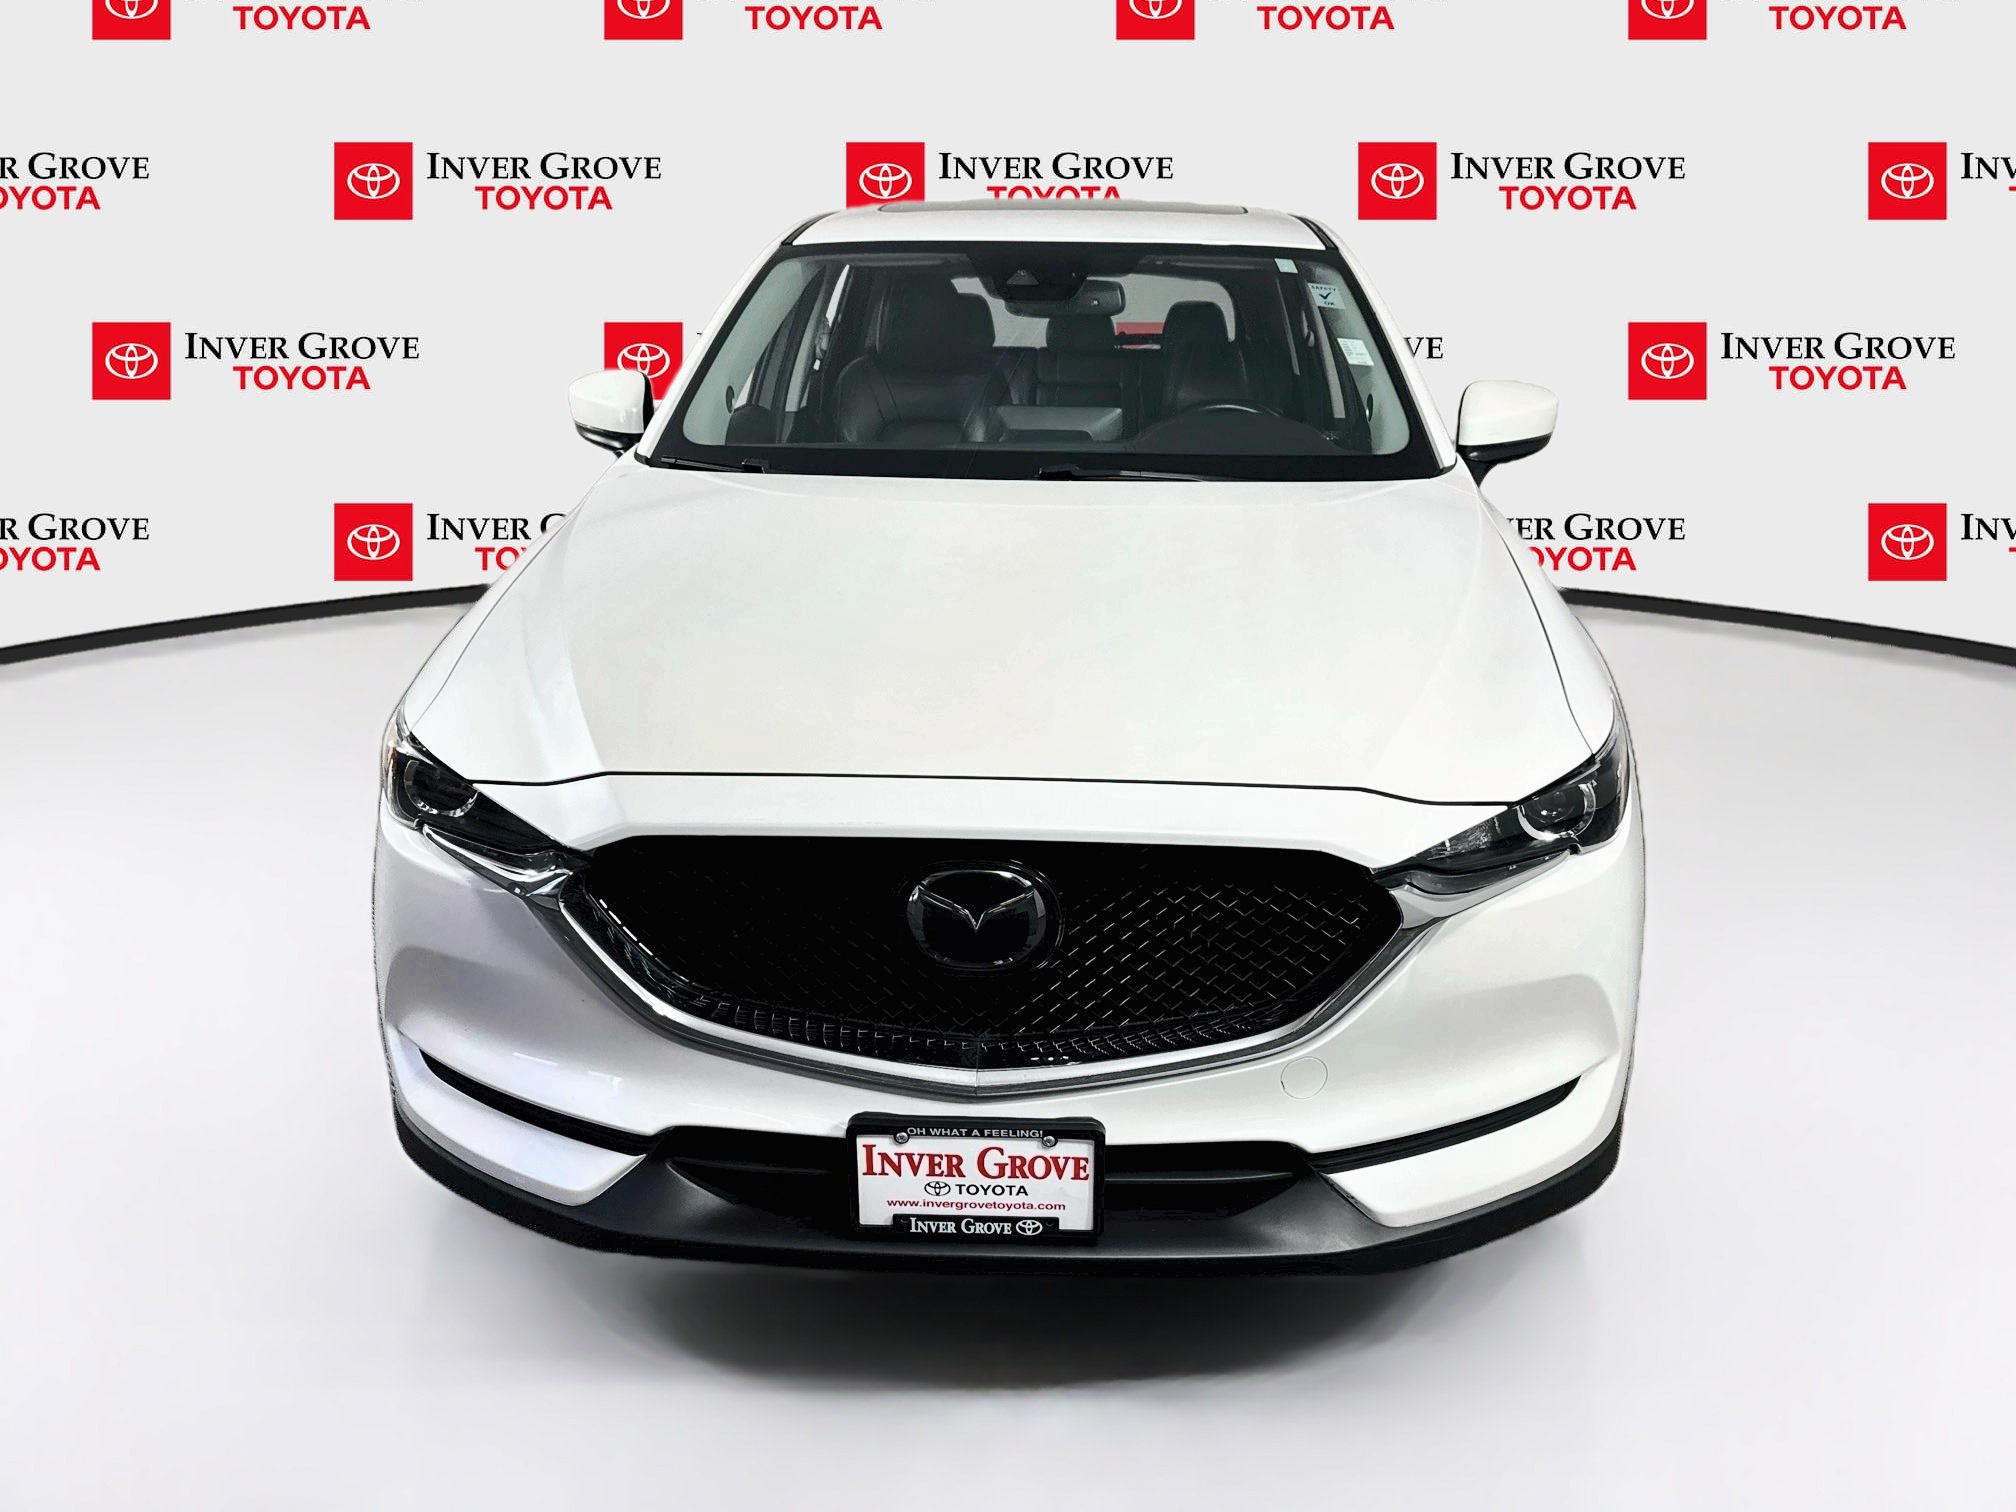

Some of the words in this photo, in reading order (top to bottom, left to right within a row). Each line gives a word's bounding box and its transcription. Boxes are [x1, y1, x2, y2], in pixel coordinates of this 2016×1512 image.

[232, 5, 371, 31] TOYOTA
[744, 5, 883, 31] TOYOTA
[1256, 5, 1395, 31] TOYOTA
[1768, 5, 1907, 31] TOYOTA
[28, 152, 150, 180] GROVE
[426, 153, 531, 180] INVER
[540, 152, 662, 180] GROVE
[938, 153, 1043, 180] INVER
[1052, 152, 1174, 180] GROVE
[1450, 153, 1555, 180] INVER
[1564, 152, 1686, 180] GROVE
[474, 185, 613, 211] TOYOTA
[1498, 185, 1637, 211] TOYOTA
[184, 333, 289, 360] INVER
[298, 332, 420, 360] GROVE
[1720, 333, 1825, 360] INVER
[1834, 332, 1956, 360] GROVE
[232, 365, 371, 391] TOYOTA
[1768, 365, 1907, 391] TOYOTA
[28, 513, 150, 541] GROVE
[426, 514, 531, 541] INVER
[1564, 513, 1686, 541] GROVE
[907, 1127, 925, 1136] OH
[930, 1128, 968, 1137] WHAT
[971, 1129, 981, 1137] A
[984, 1129, 1043, 1139] FEELING!
[862, 1144, 966, 1178] INVER
[977, 1146, 1090, 1181] GROVE
[956, 1184, 1029, 1197] TOYOTA
[887, 1198, 1066, 1212] www.invergrovetoyota.com
[909, 1217, 957, 1234] INVER
[960, 1218, 1012, 1235] GROVE
